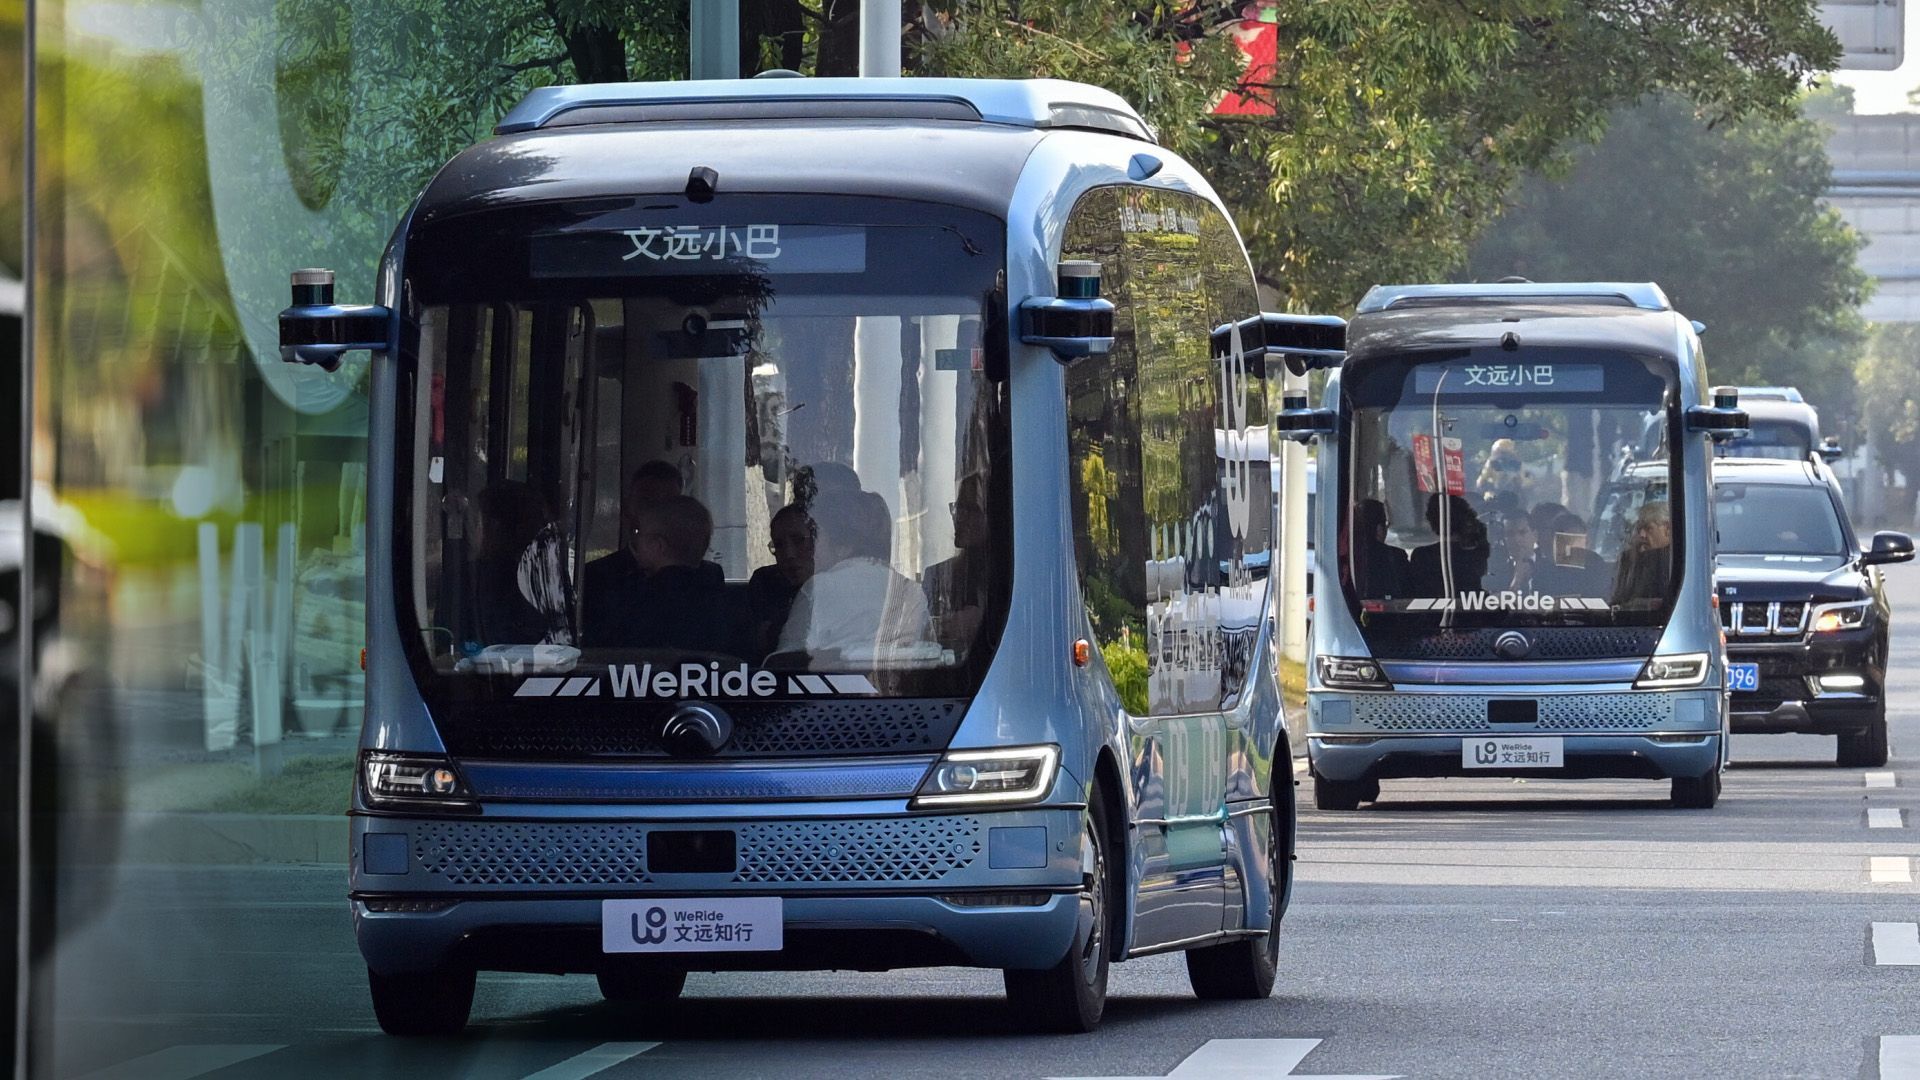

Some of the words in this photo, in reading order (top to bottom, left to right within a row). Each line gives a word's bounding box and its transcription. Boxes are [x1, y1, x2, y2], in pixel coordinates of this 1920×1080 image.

[622, 224, 782, 261] 文远小巴
[1464, 364, 1554, 386] 文远小巴
[1460, 590, 1555, 611] WeRide
[608, 661, 778, 698] WeRide
[1501, 743, 1533, 751] WeRide
[1501, 751, 1551, 764] 文远知行
[674, 910, 724, 922] WeRide
[673, 922, 753, 943] 文远知行
